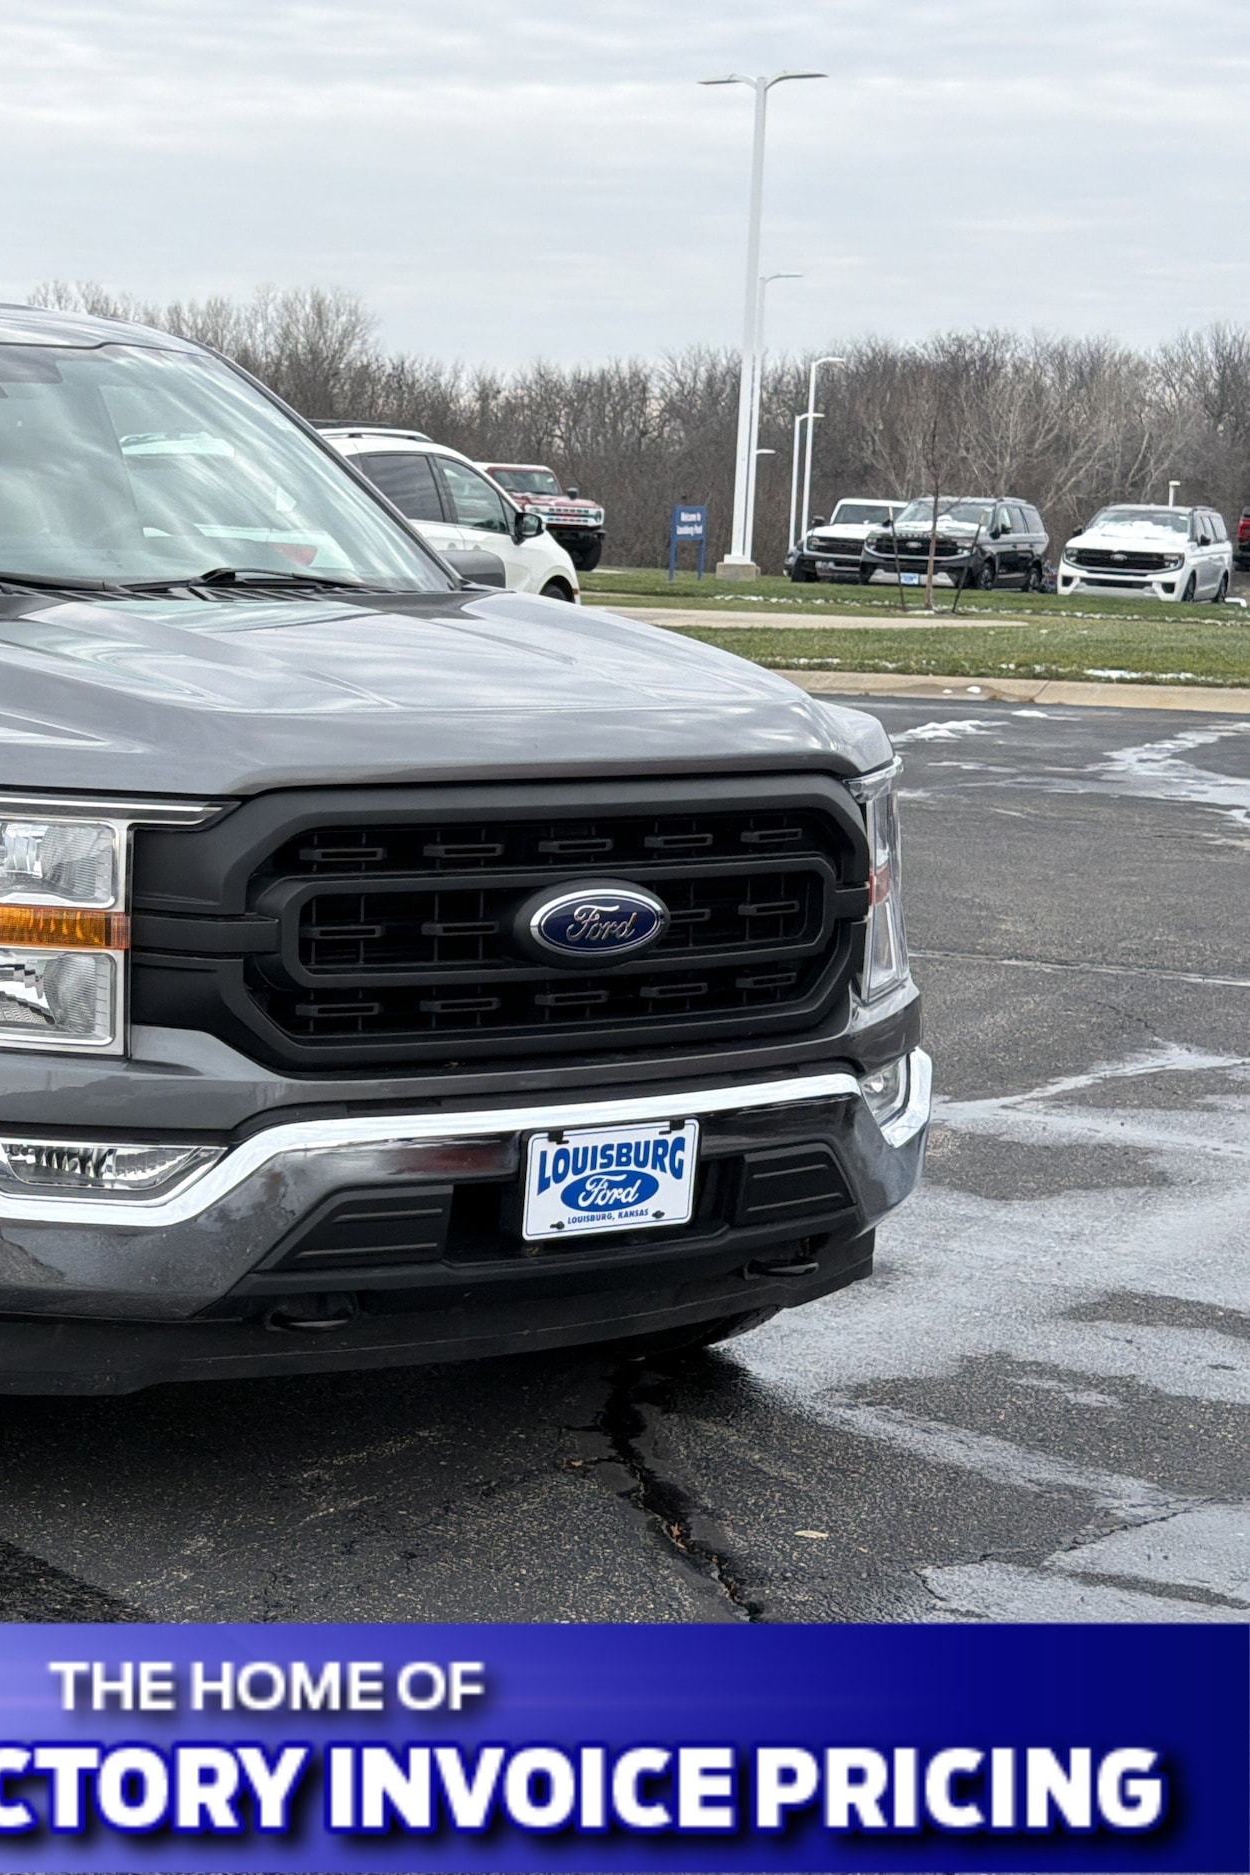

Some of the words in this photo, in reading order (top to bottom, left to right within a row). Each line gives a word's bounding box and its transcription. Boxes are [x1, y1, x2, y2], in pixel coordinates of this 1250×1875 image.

[565, 904, 637, 942] Ford
[537, 1136, 686, 1195] LOUISBURG
[578, 1174, 639, 1207] Ford
[567, 1213, 616, 1225] LOUISBURG,
[618, 1208, 649, 1219] KANSAS
